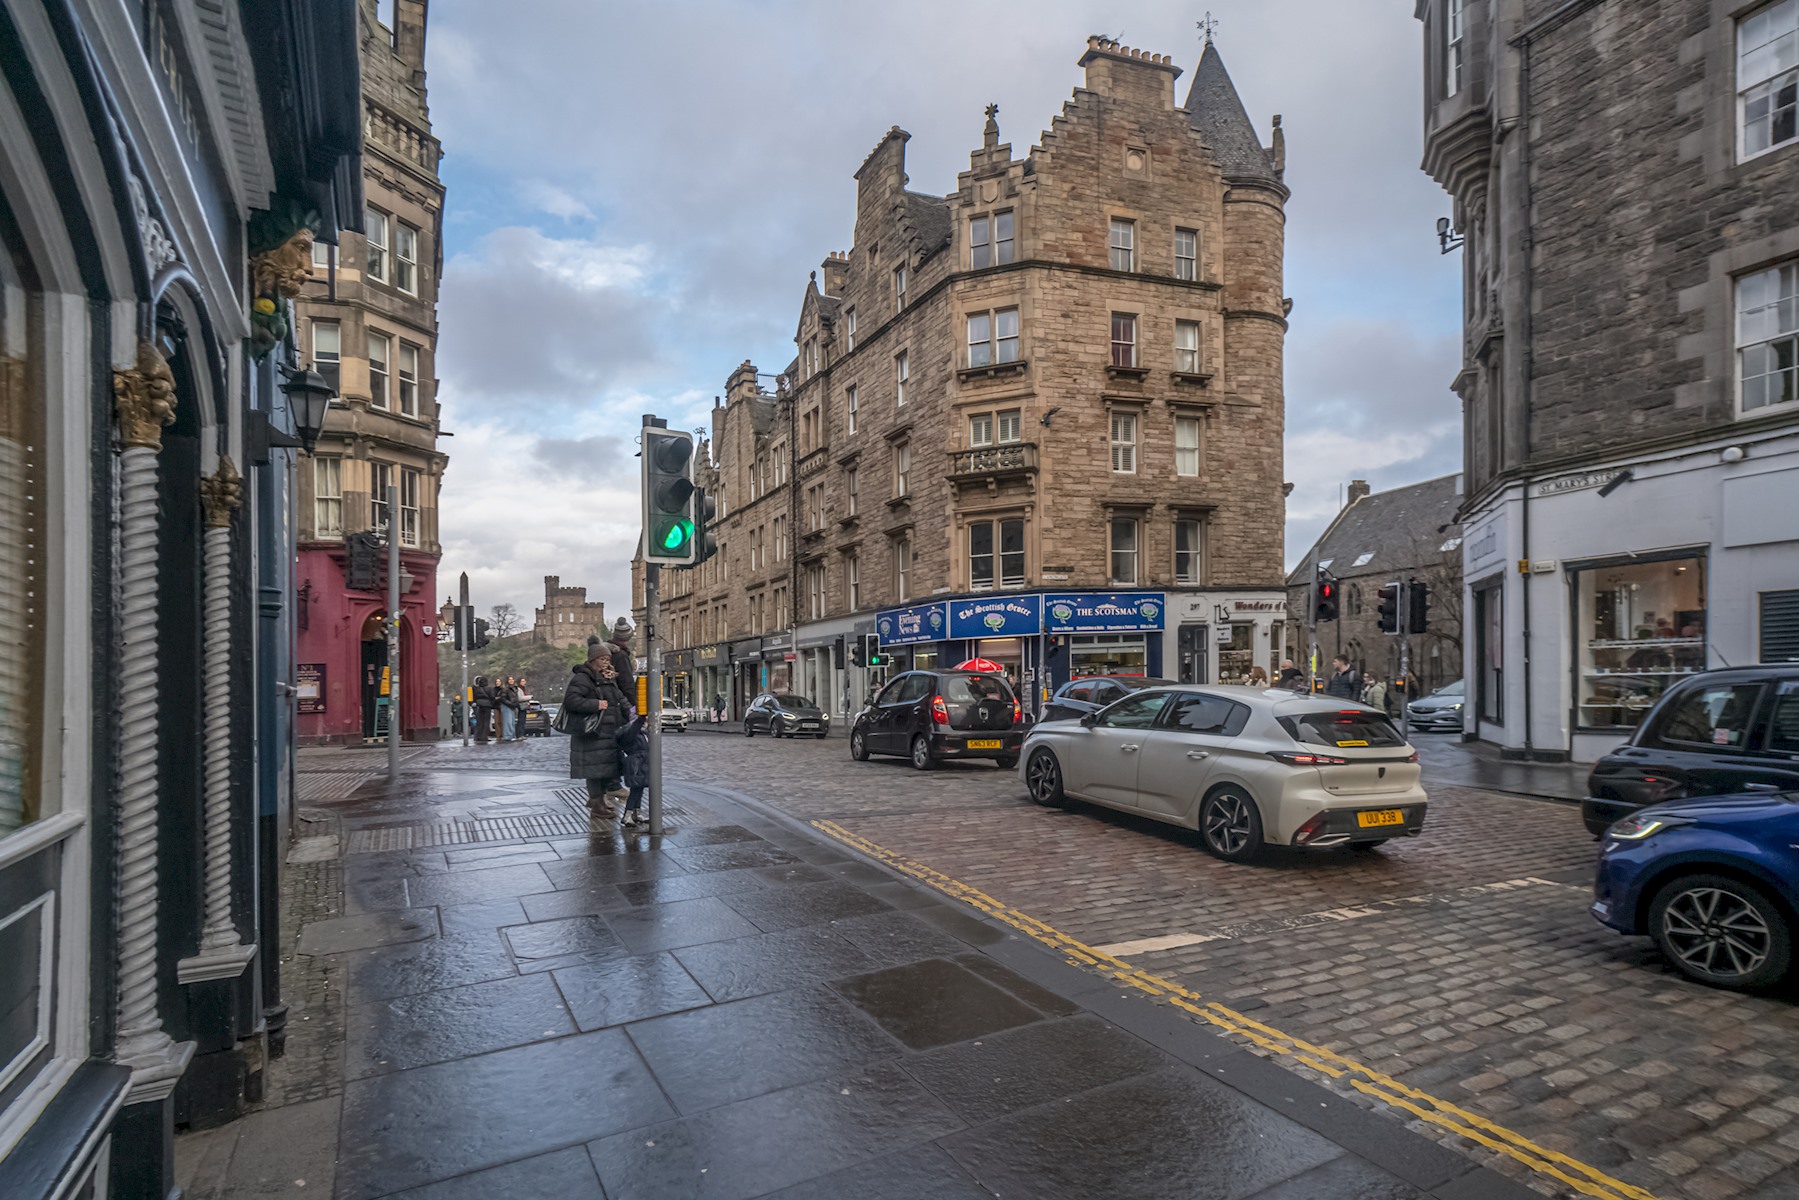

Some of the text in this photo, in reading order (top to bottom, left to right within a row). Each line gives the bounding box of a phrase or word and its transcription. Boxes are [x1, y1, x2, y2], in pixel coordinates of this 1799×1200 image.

[1190, 603, 1200, 611] 297
[1235, 601, 1273, 610] Wonders
[1275, 601, 1282, 611] of
[959, 603, 1032, 620] The Scottish Grocer
[1076, 607, 1137, 616] THE SCOTSMAN
[1380, 811, 1396, 823] 338
